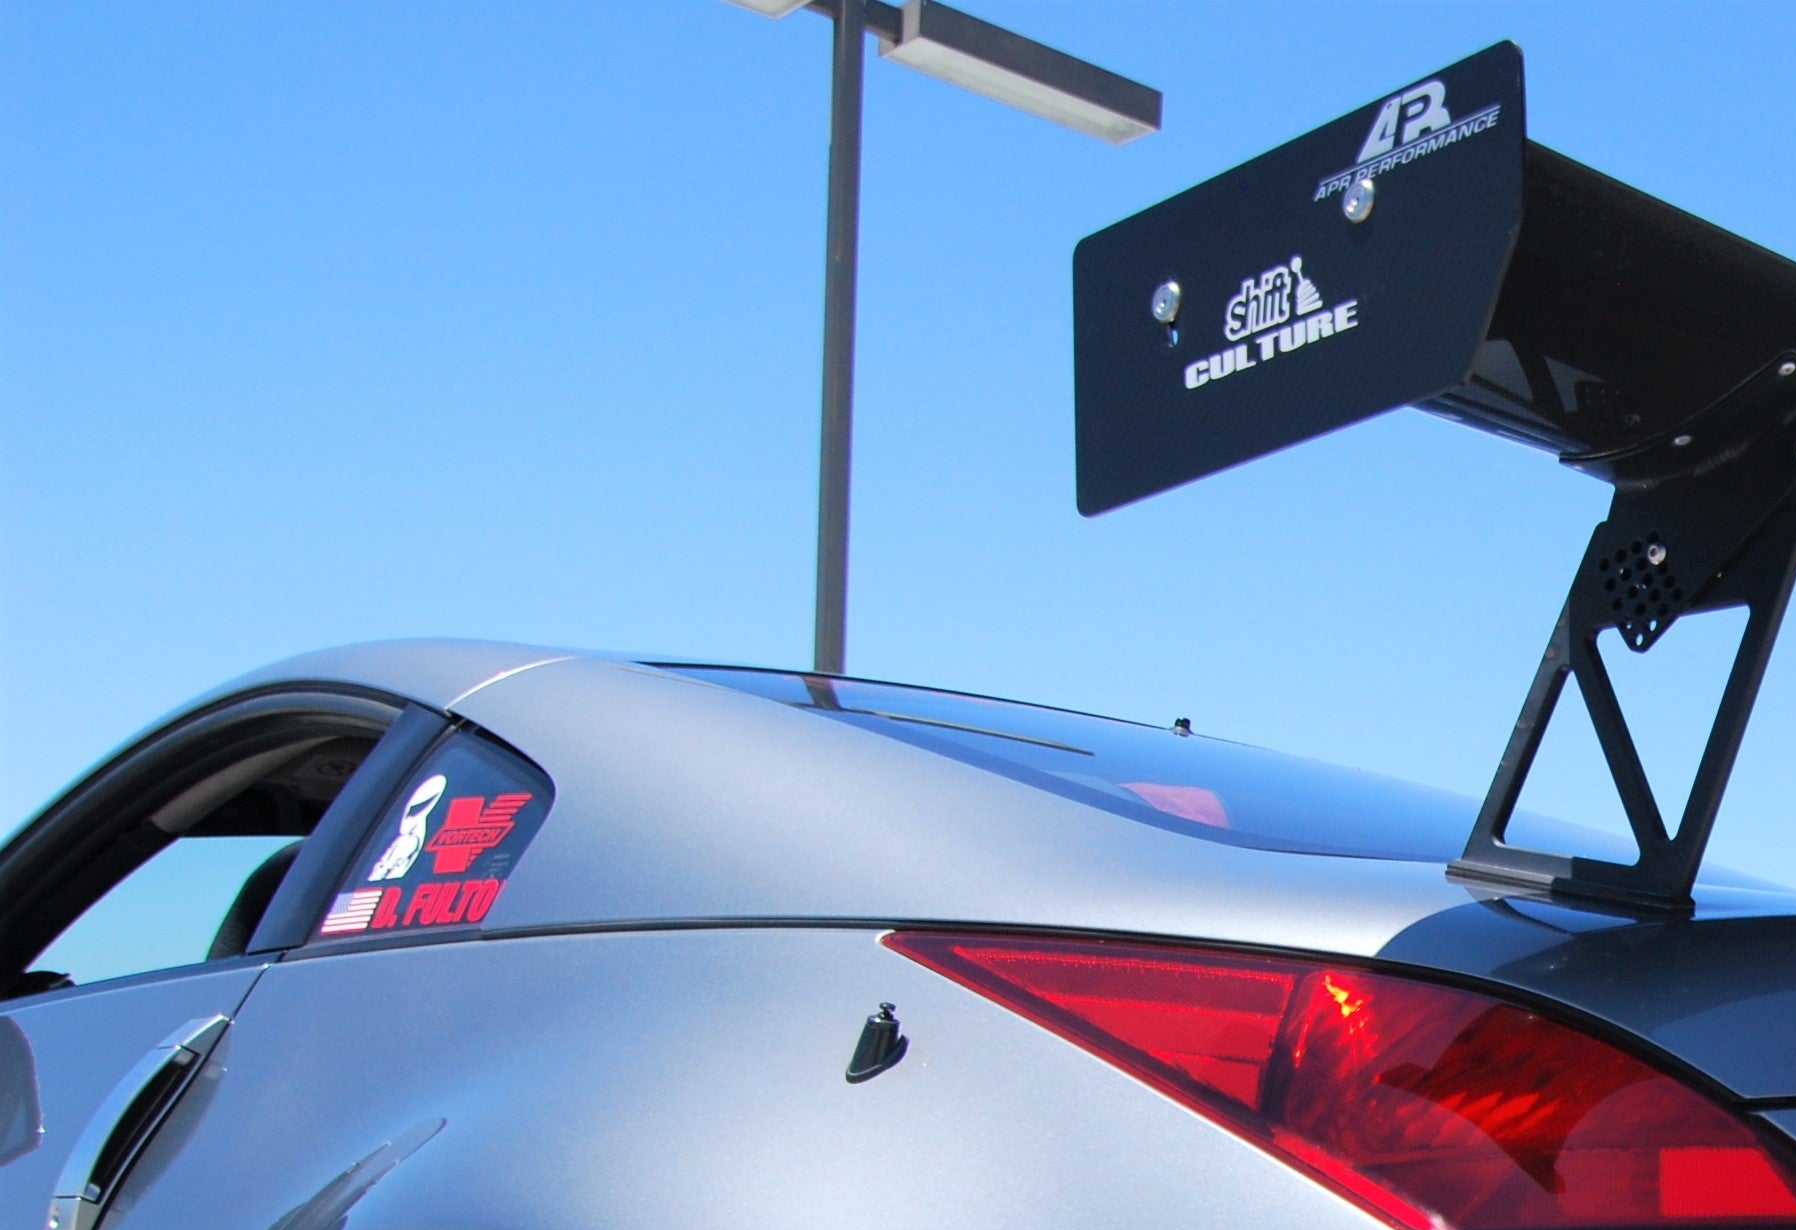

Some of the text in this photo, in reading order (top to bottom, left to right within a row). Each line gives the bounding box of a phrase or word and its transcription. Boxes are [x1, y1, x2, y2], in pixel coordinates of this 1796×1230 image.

[1314, 110, 1500, 202] APR PERFORMANCE
[1184, 299, 1359, 390] CULTURE
[402, 878, 507, 926] FULTO
